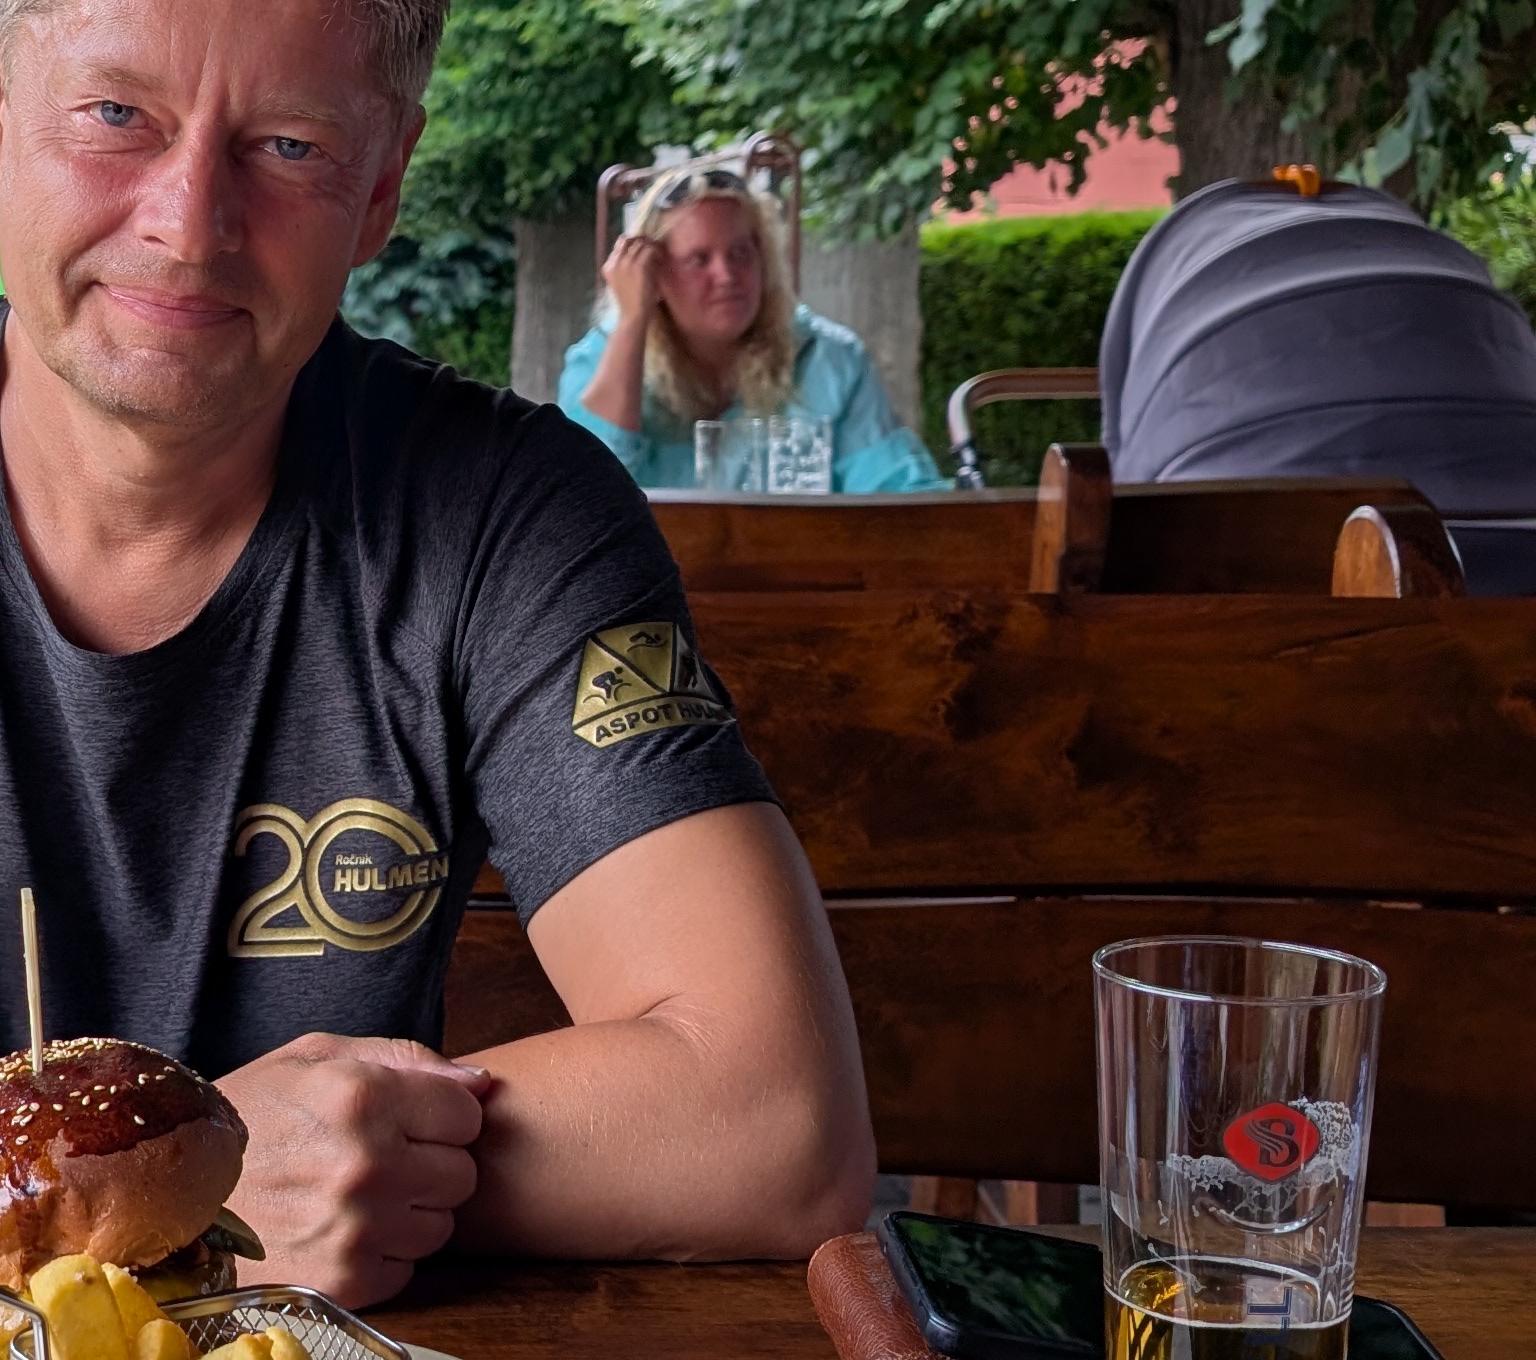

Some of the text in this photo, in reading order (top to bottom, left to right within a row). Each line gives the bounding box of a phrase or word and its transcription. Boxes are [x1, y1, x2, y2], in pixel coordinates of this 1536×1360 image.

[594, 702, 718, 743] ASPOT HUL
[227, 797, 442, 958] 20
[333, 855, 450, 893] HULMEN
